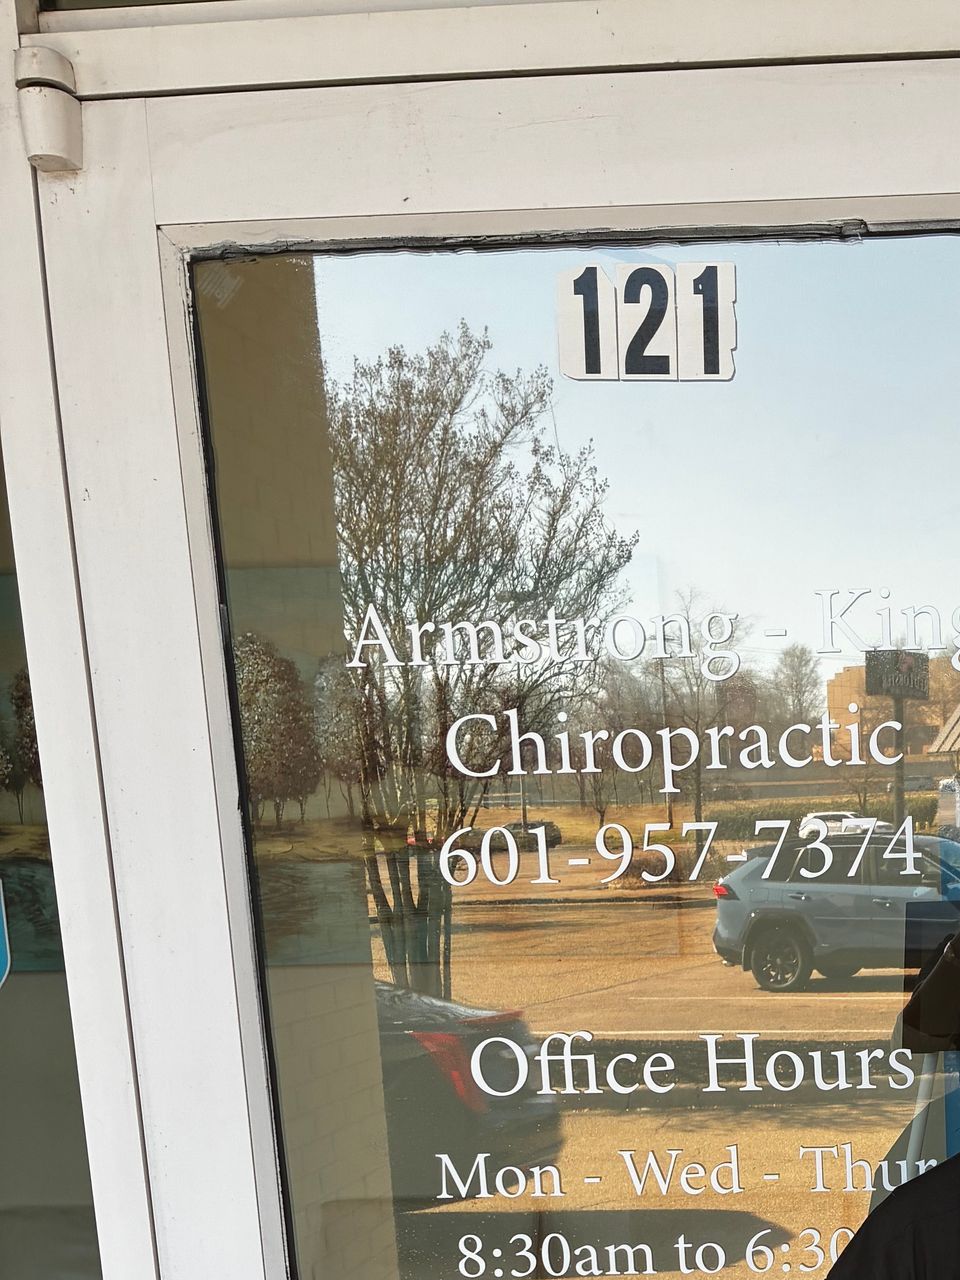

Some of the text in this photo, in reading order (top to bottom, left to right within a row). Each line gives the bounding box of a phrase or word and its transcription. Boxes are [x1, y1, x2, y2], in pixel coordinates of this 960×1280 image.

[573, 266, 720, 374] 121
[345, 603, 740, 681] Armstrong
[446, 702, 904, 793] Chiropractic
[439, 816, 923, 887] 601-957-7374
[470, 1030, 915, 1097] Office Hours
[435, 1152, 566, 1199] Mon
[617, 1144, 745, 1196] Wed
[458, 1232, 657, 1278] 8:30am
[673, 1233, 726, 1275] to
